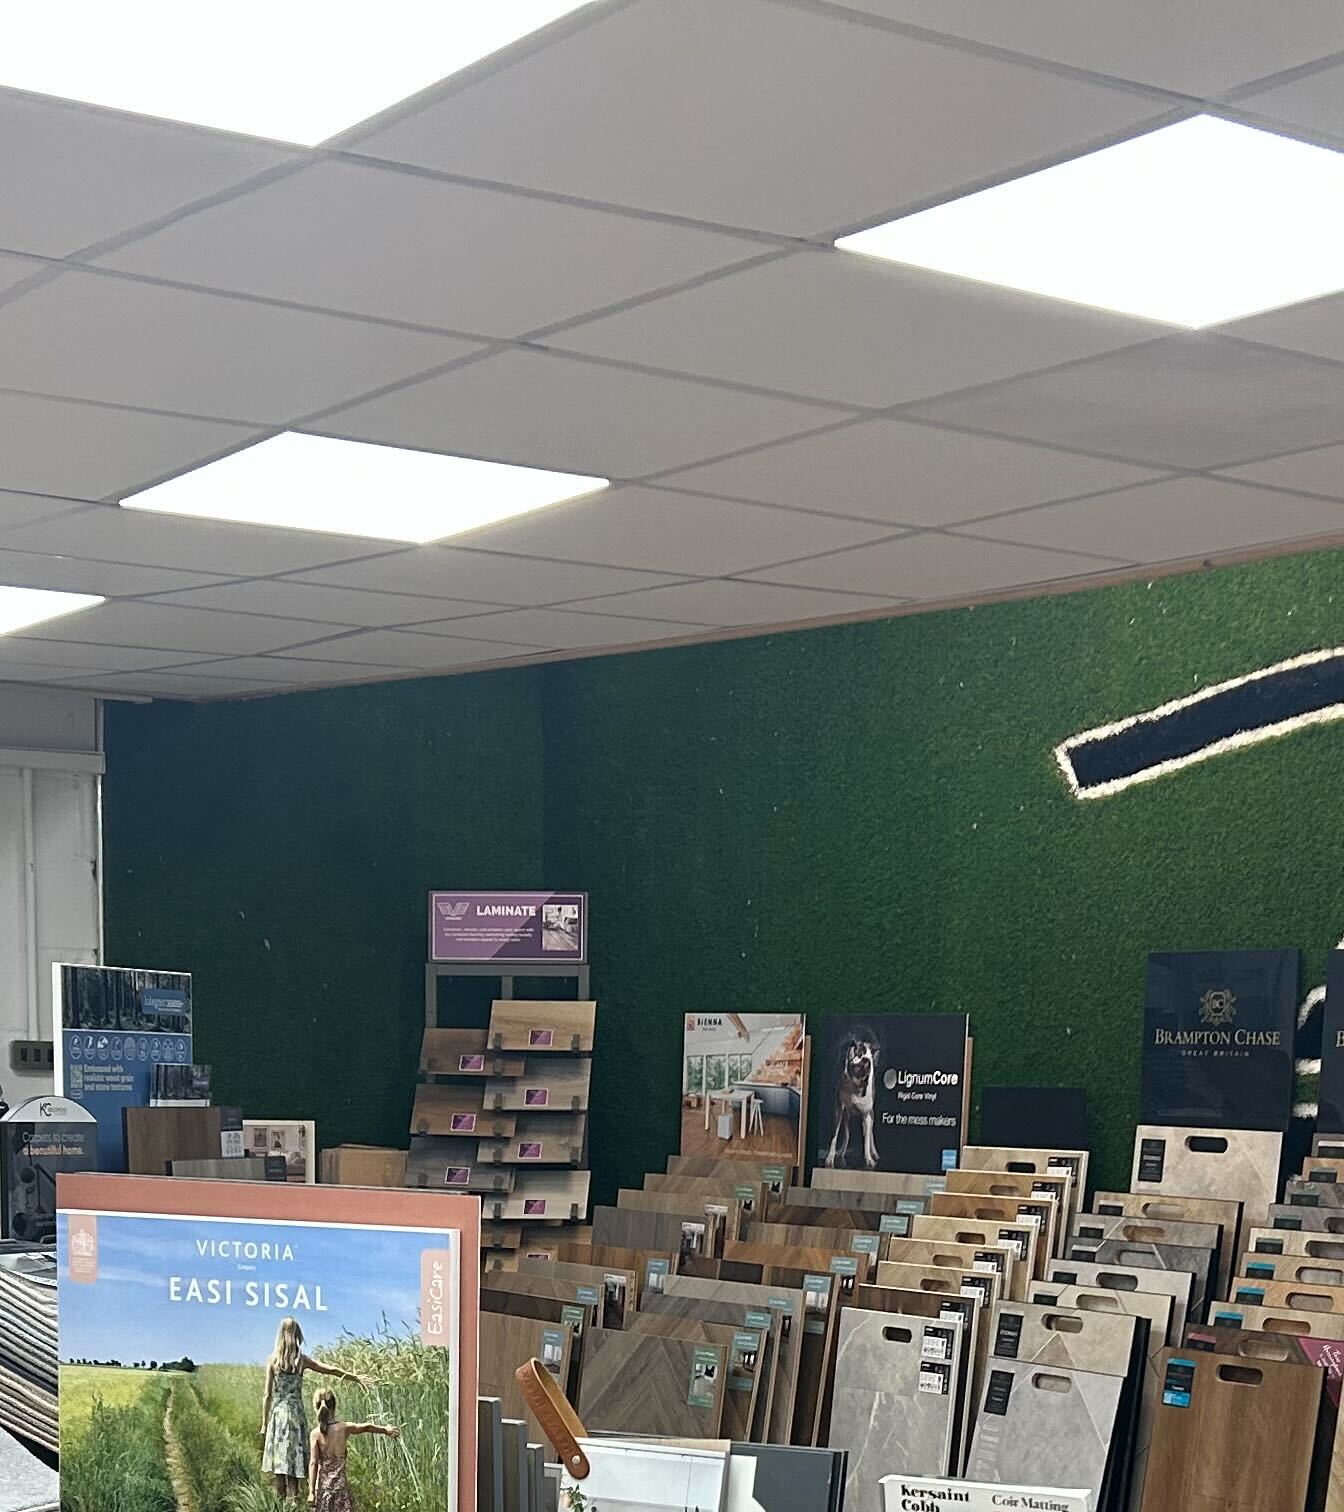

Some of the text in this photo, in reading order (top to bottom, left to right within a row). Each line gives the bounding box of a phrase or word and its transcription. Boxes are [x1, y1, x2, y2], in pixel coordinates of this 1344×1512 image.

[476, 905, 536, 917] LAMINATE
[1155, 1029, 1281, 1046] BRAMPTON CHASE
[898, 1070, 958, 1088] LignumCore
[882, 1112, 895, 1125] For
[896, 1113, 907, 1125] the
[22, 1132, 52, 1143] Carpets
[30, 1145, 61, 1156] beautiful
[62, 1145, 85, 1155] home.
[195, 1239, 295, 1261] VICTORIA
[169, 1277, 329, 1311] EASI SISAL
[426, 1260, 445, 1337] EasiCare
[900, 1484, 969, 1503] Kersaint
[992, 1494, 1019, 1508] Coir
